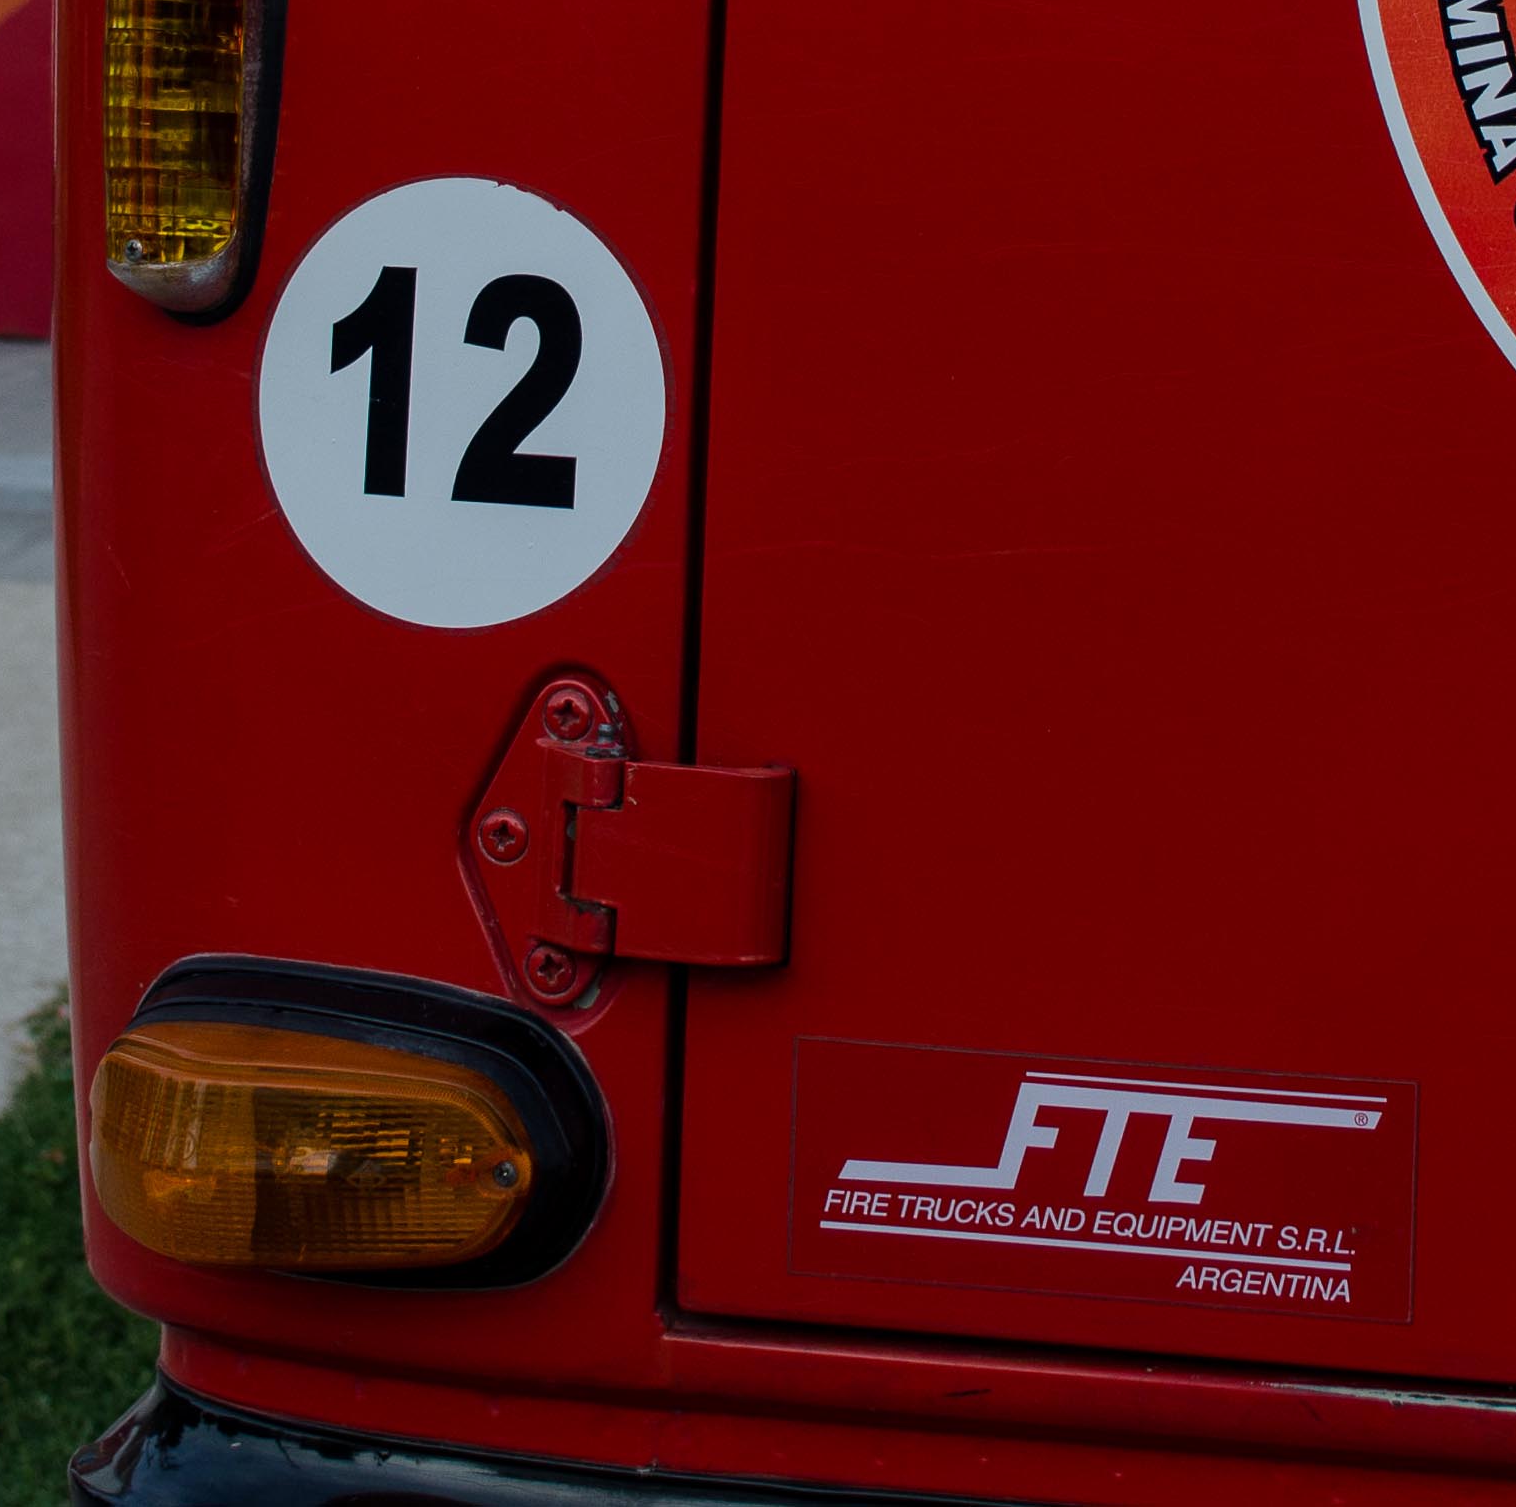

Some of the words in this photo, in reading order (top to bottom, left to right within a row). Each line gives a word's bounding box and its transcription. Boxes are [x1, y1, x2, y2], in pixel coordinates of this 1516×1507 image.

[330, 266, 583, 510] 12
[996, 1082, 1217, 1204] FTE
[824, 1190, 891, 1218] FIRE
[898, 1194, 1016, 1228] TRUCKS
[1020, 1204, 1087, 1233] AND
[1092, 1210, 1272, 1249] EQUIPMENT
[1276, 1225, 1357, 1255] S.R.L.
[1176, 1265, 1352, 1303] ARGENTINA
